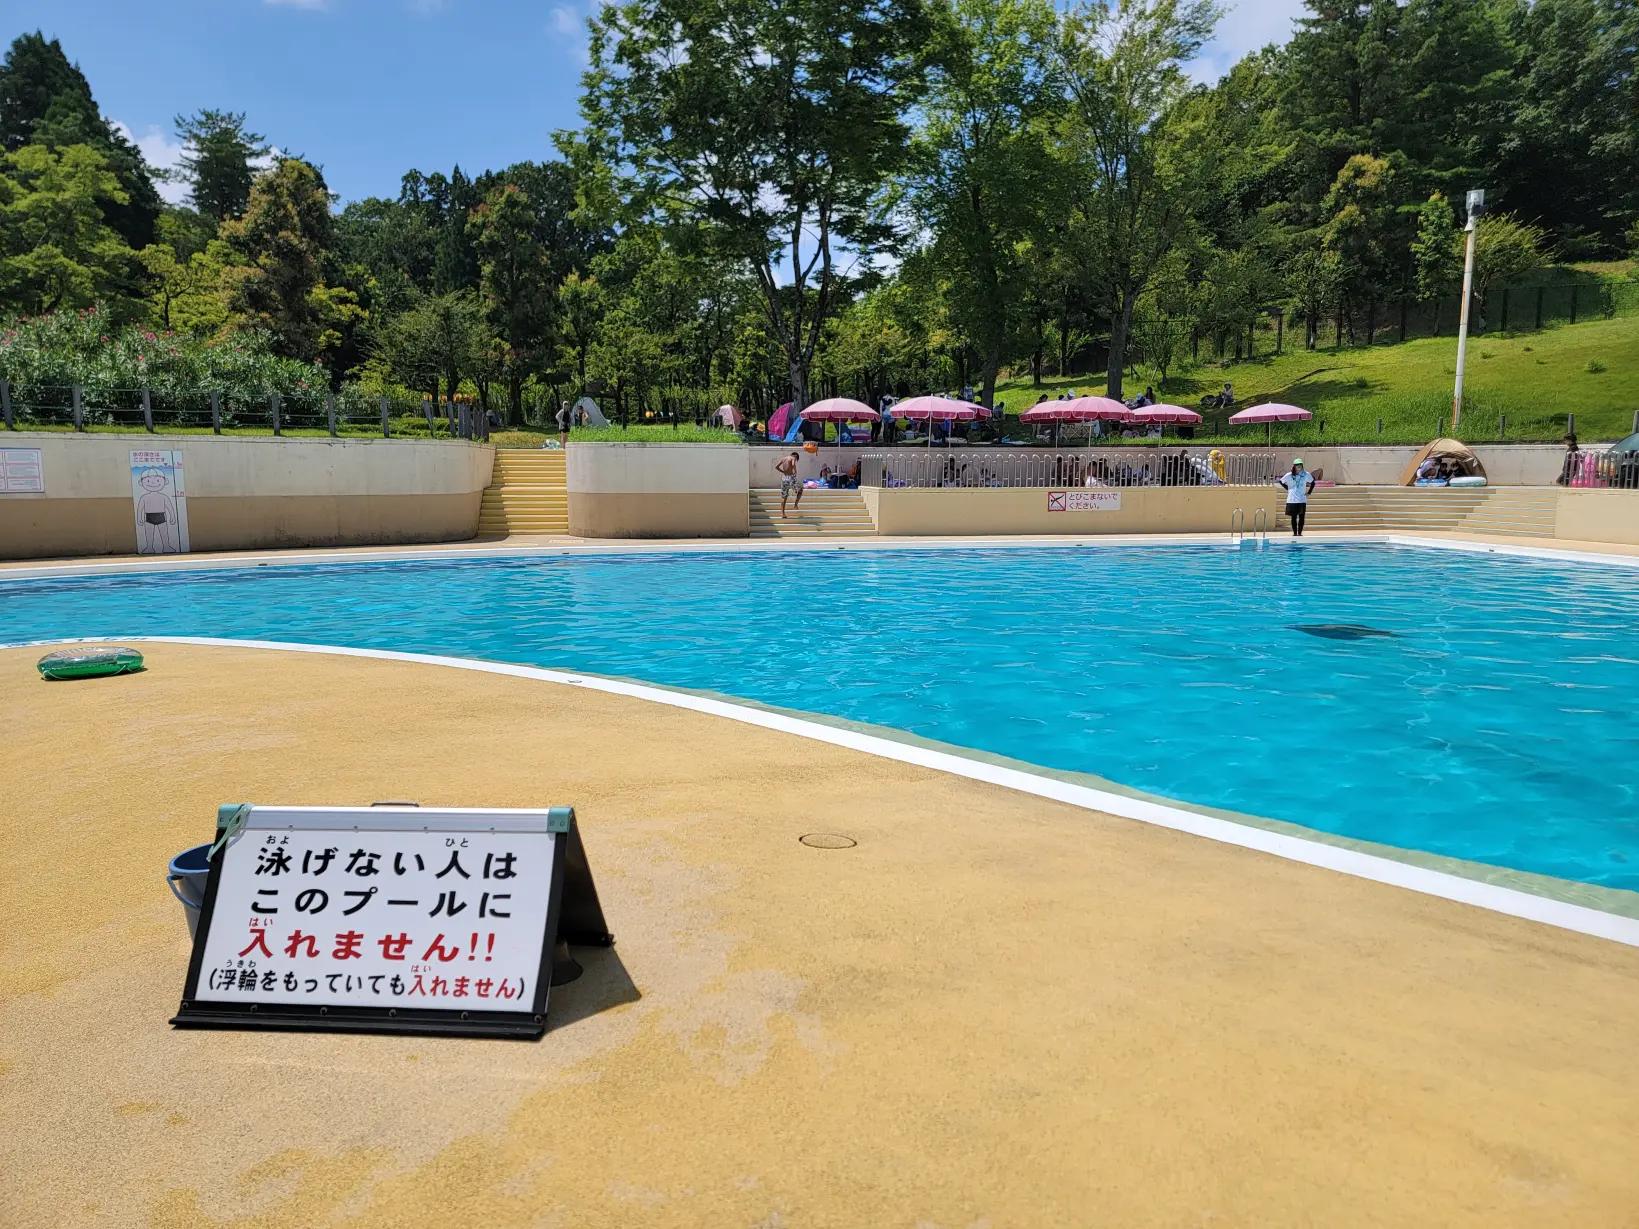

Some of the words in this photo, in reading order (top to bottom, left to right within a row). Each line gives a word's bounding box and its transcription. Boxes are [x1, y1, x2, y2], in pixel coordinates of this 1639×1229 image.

[1068, 492, 1118, 501] とびこまないで
[266, 835, 289, 845] およ
[445, 837, 469, 847] ひと
[254, 846, 518, 880] 泳げない人は
[250, 886, 512, 919] このプールに
[248, 917, 273, 927] はい
[238, 928, 495, 962] 入れません!!
[225, 959, 257, 968] うきわ
[410, 964, 432, 973] はい
